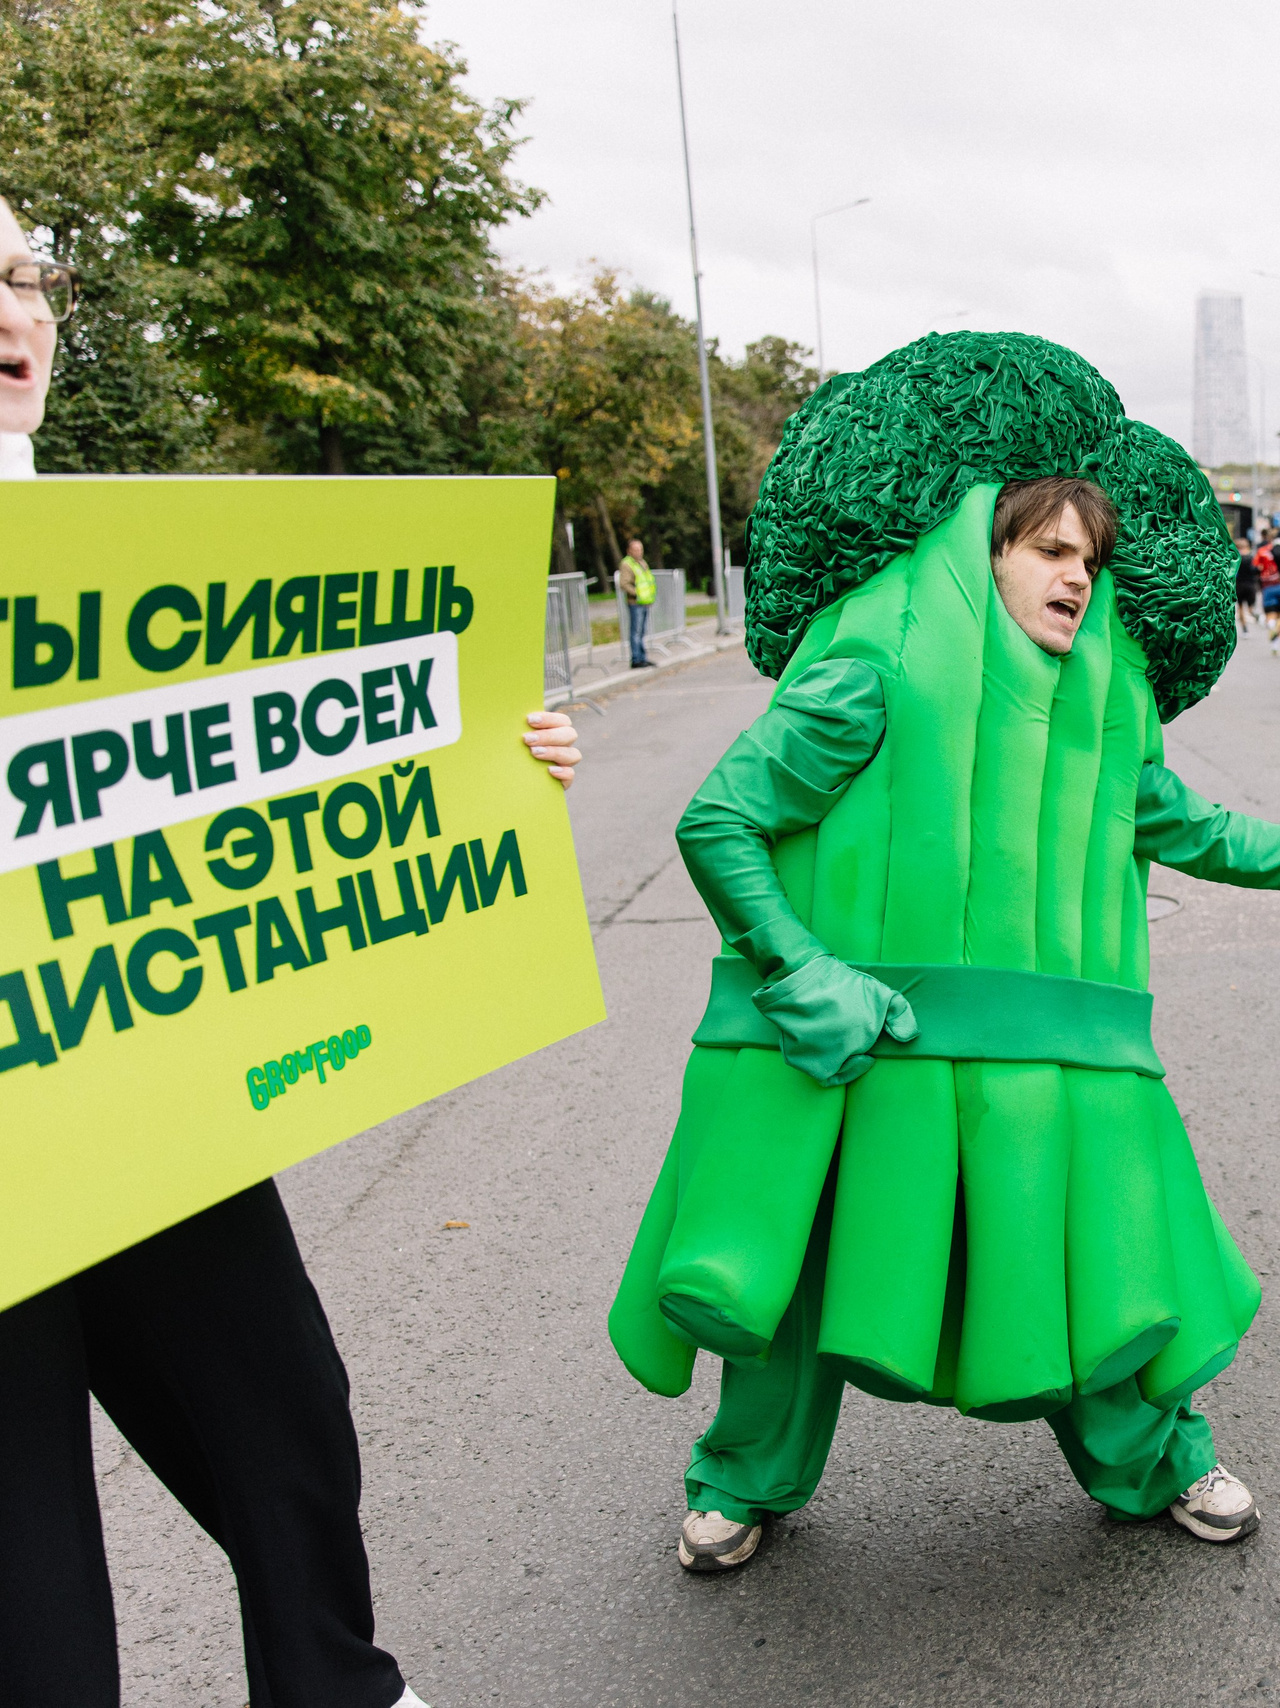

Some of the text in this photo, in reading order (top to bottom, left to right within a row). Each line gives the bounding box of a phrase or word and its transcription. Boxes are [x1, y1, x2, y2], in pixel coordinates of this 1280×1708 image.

[0, 565, 475, 690] Ы СИЯЕШЬ
[6, 657, 438, 839] ЯРЧЕ ВСЕХ
[36, 759, 442, 941] НА ЭТОЙ
[246, 1024, 372, 1111] GROWFOOD
